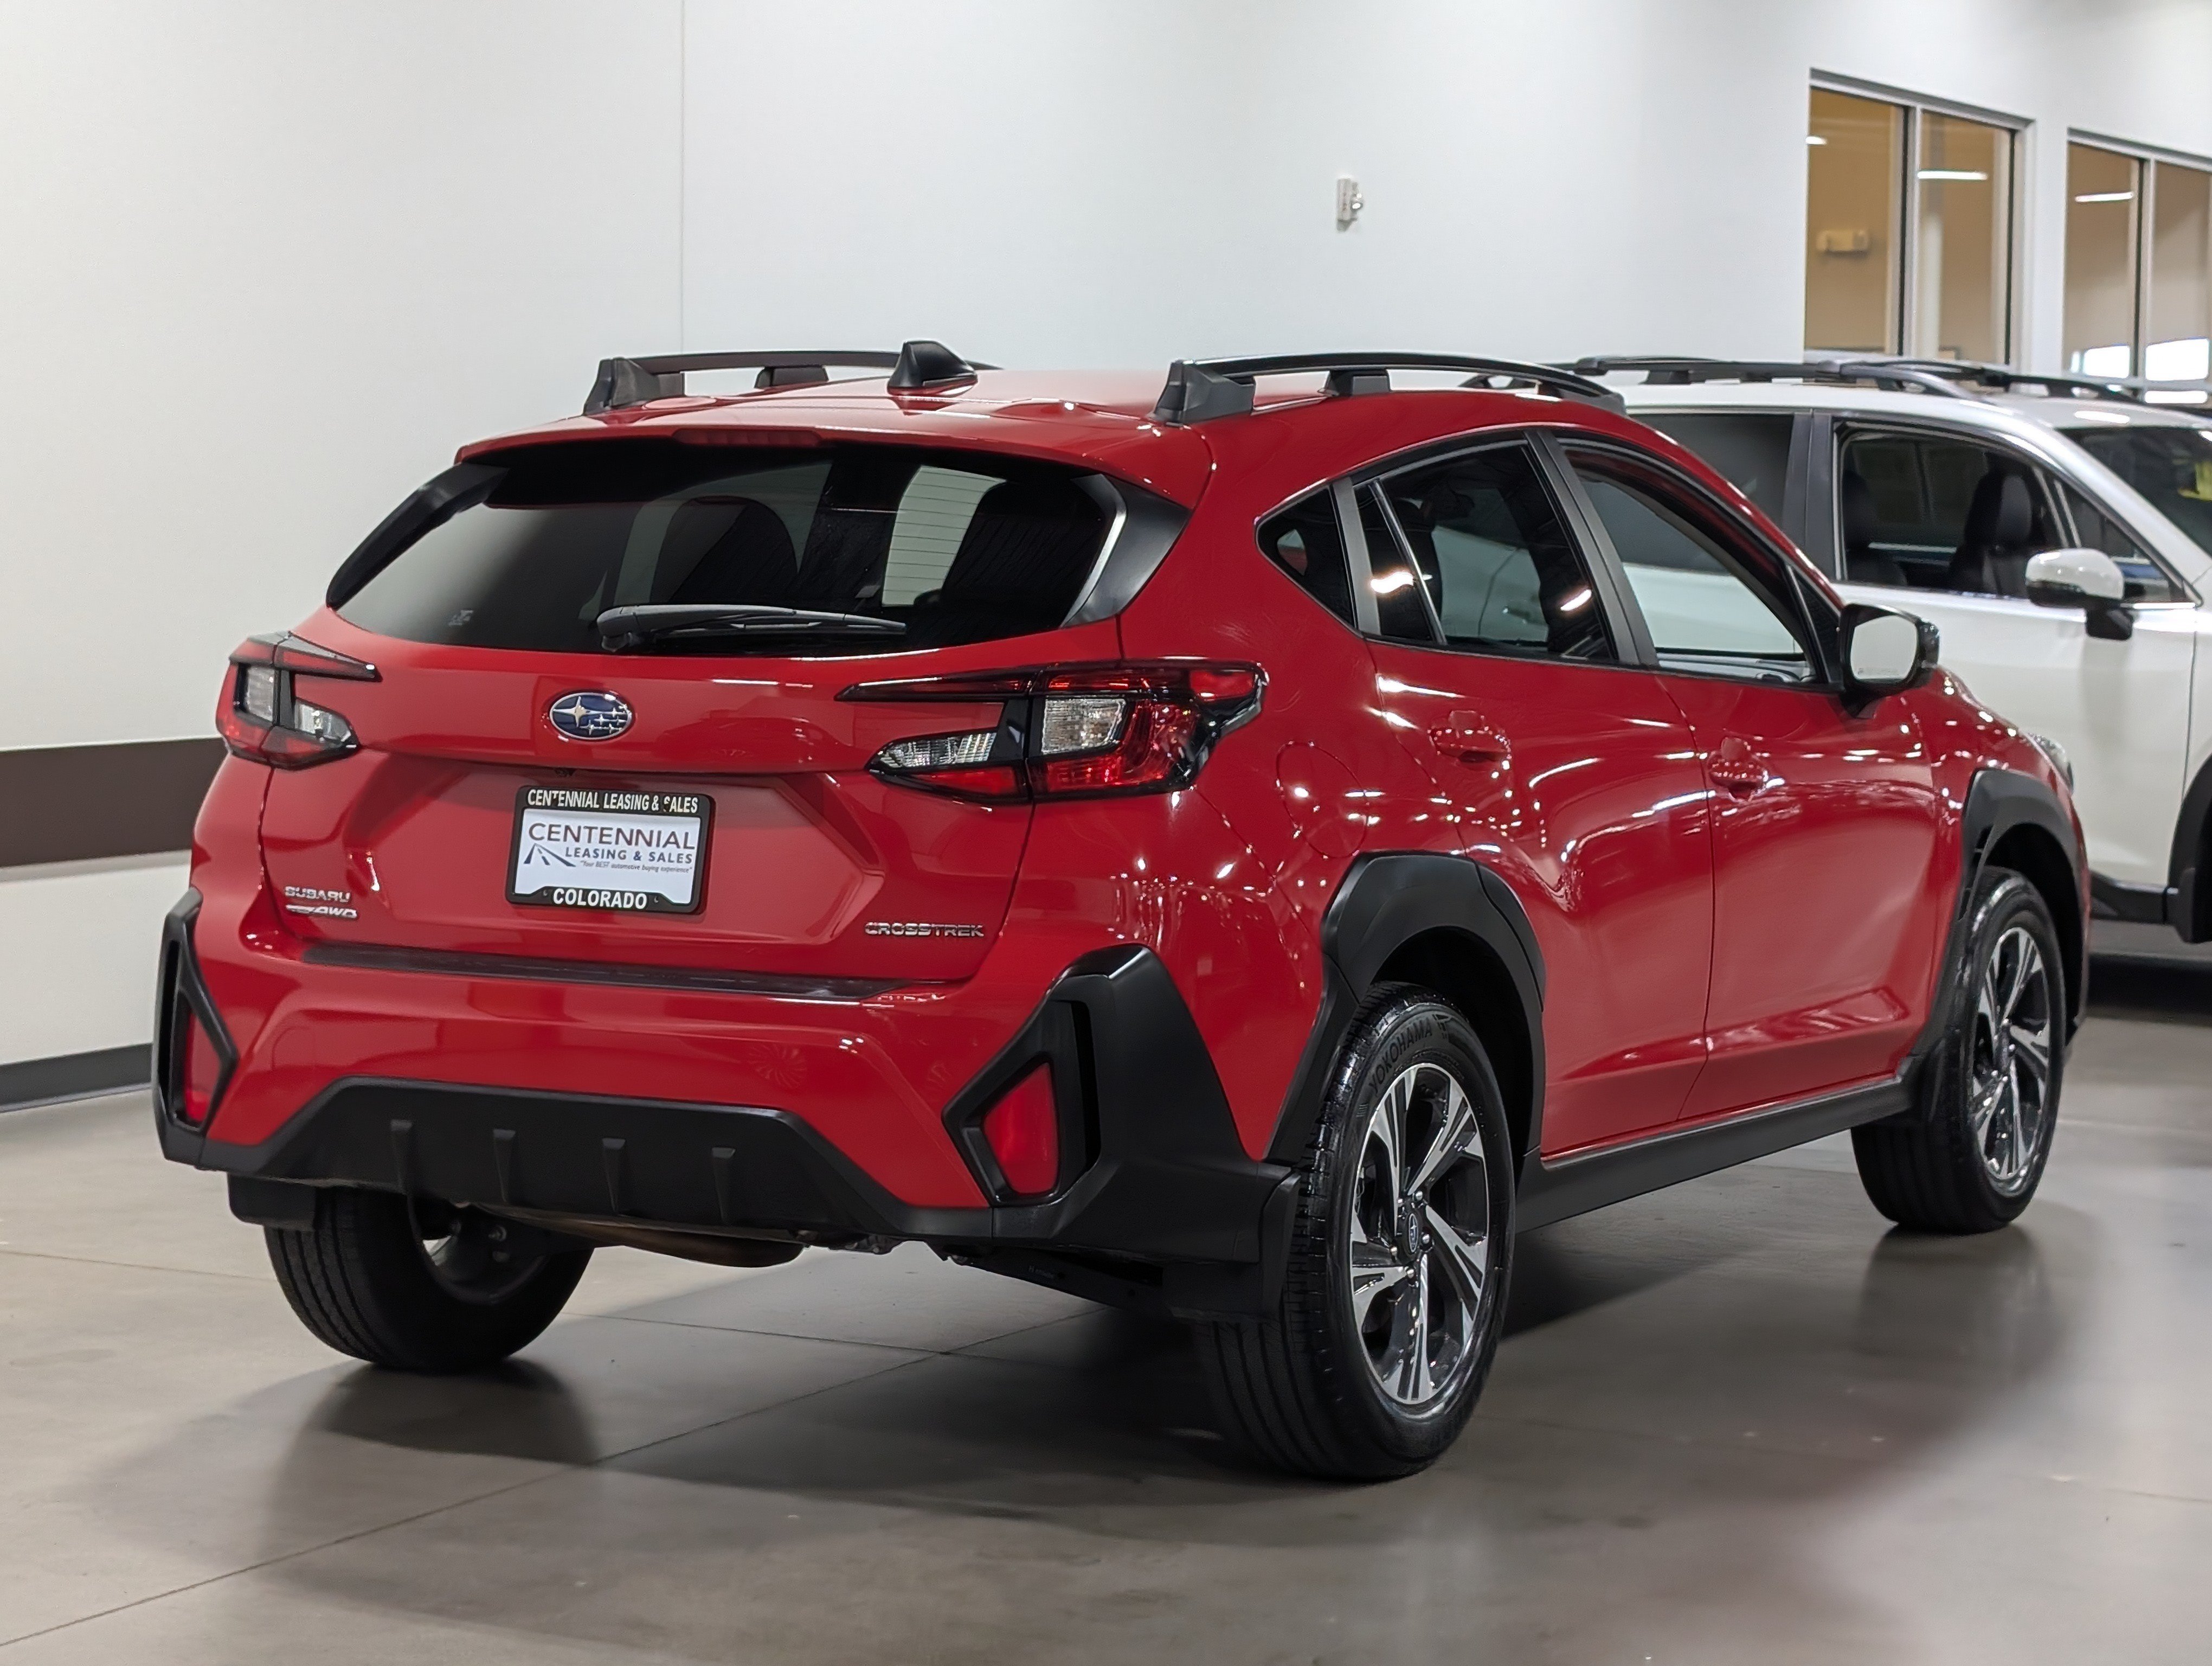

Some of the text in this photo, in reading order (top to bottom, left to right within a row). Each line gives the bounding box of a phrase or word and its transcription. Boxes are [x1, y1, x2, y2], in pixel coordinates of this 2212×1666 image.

[528, 789, 600, 808] CENTENNIAL
[603, 793, 649, 811] LEASING
[651, 795, 659, 811] &
[528, 823, 695, 850] CENTENNIAL
[565, 847, 692, 864] LEASING & SALES
[285, 886, 351, 902] SUBARU
[553, 888, 647, 909] COLORADO
[865, 922, 985, 937] CROSSTREK
[1369, 1017, 1432, 1093] YOKOHAMA
